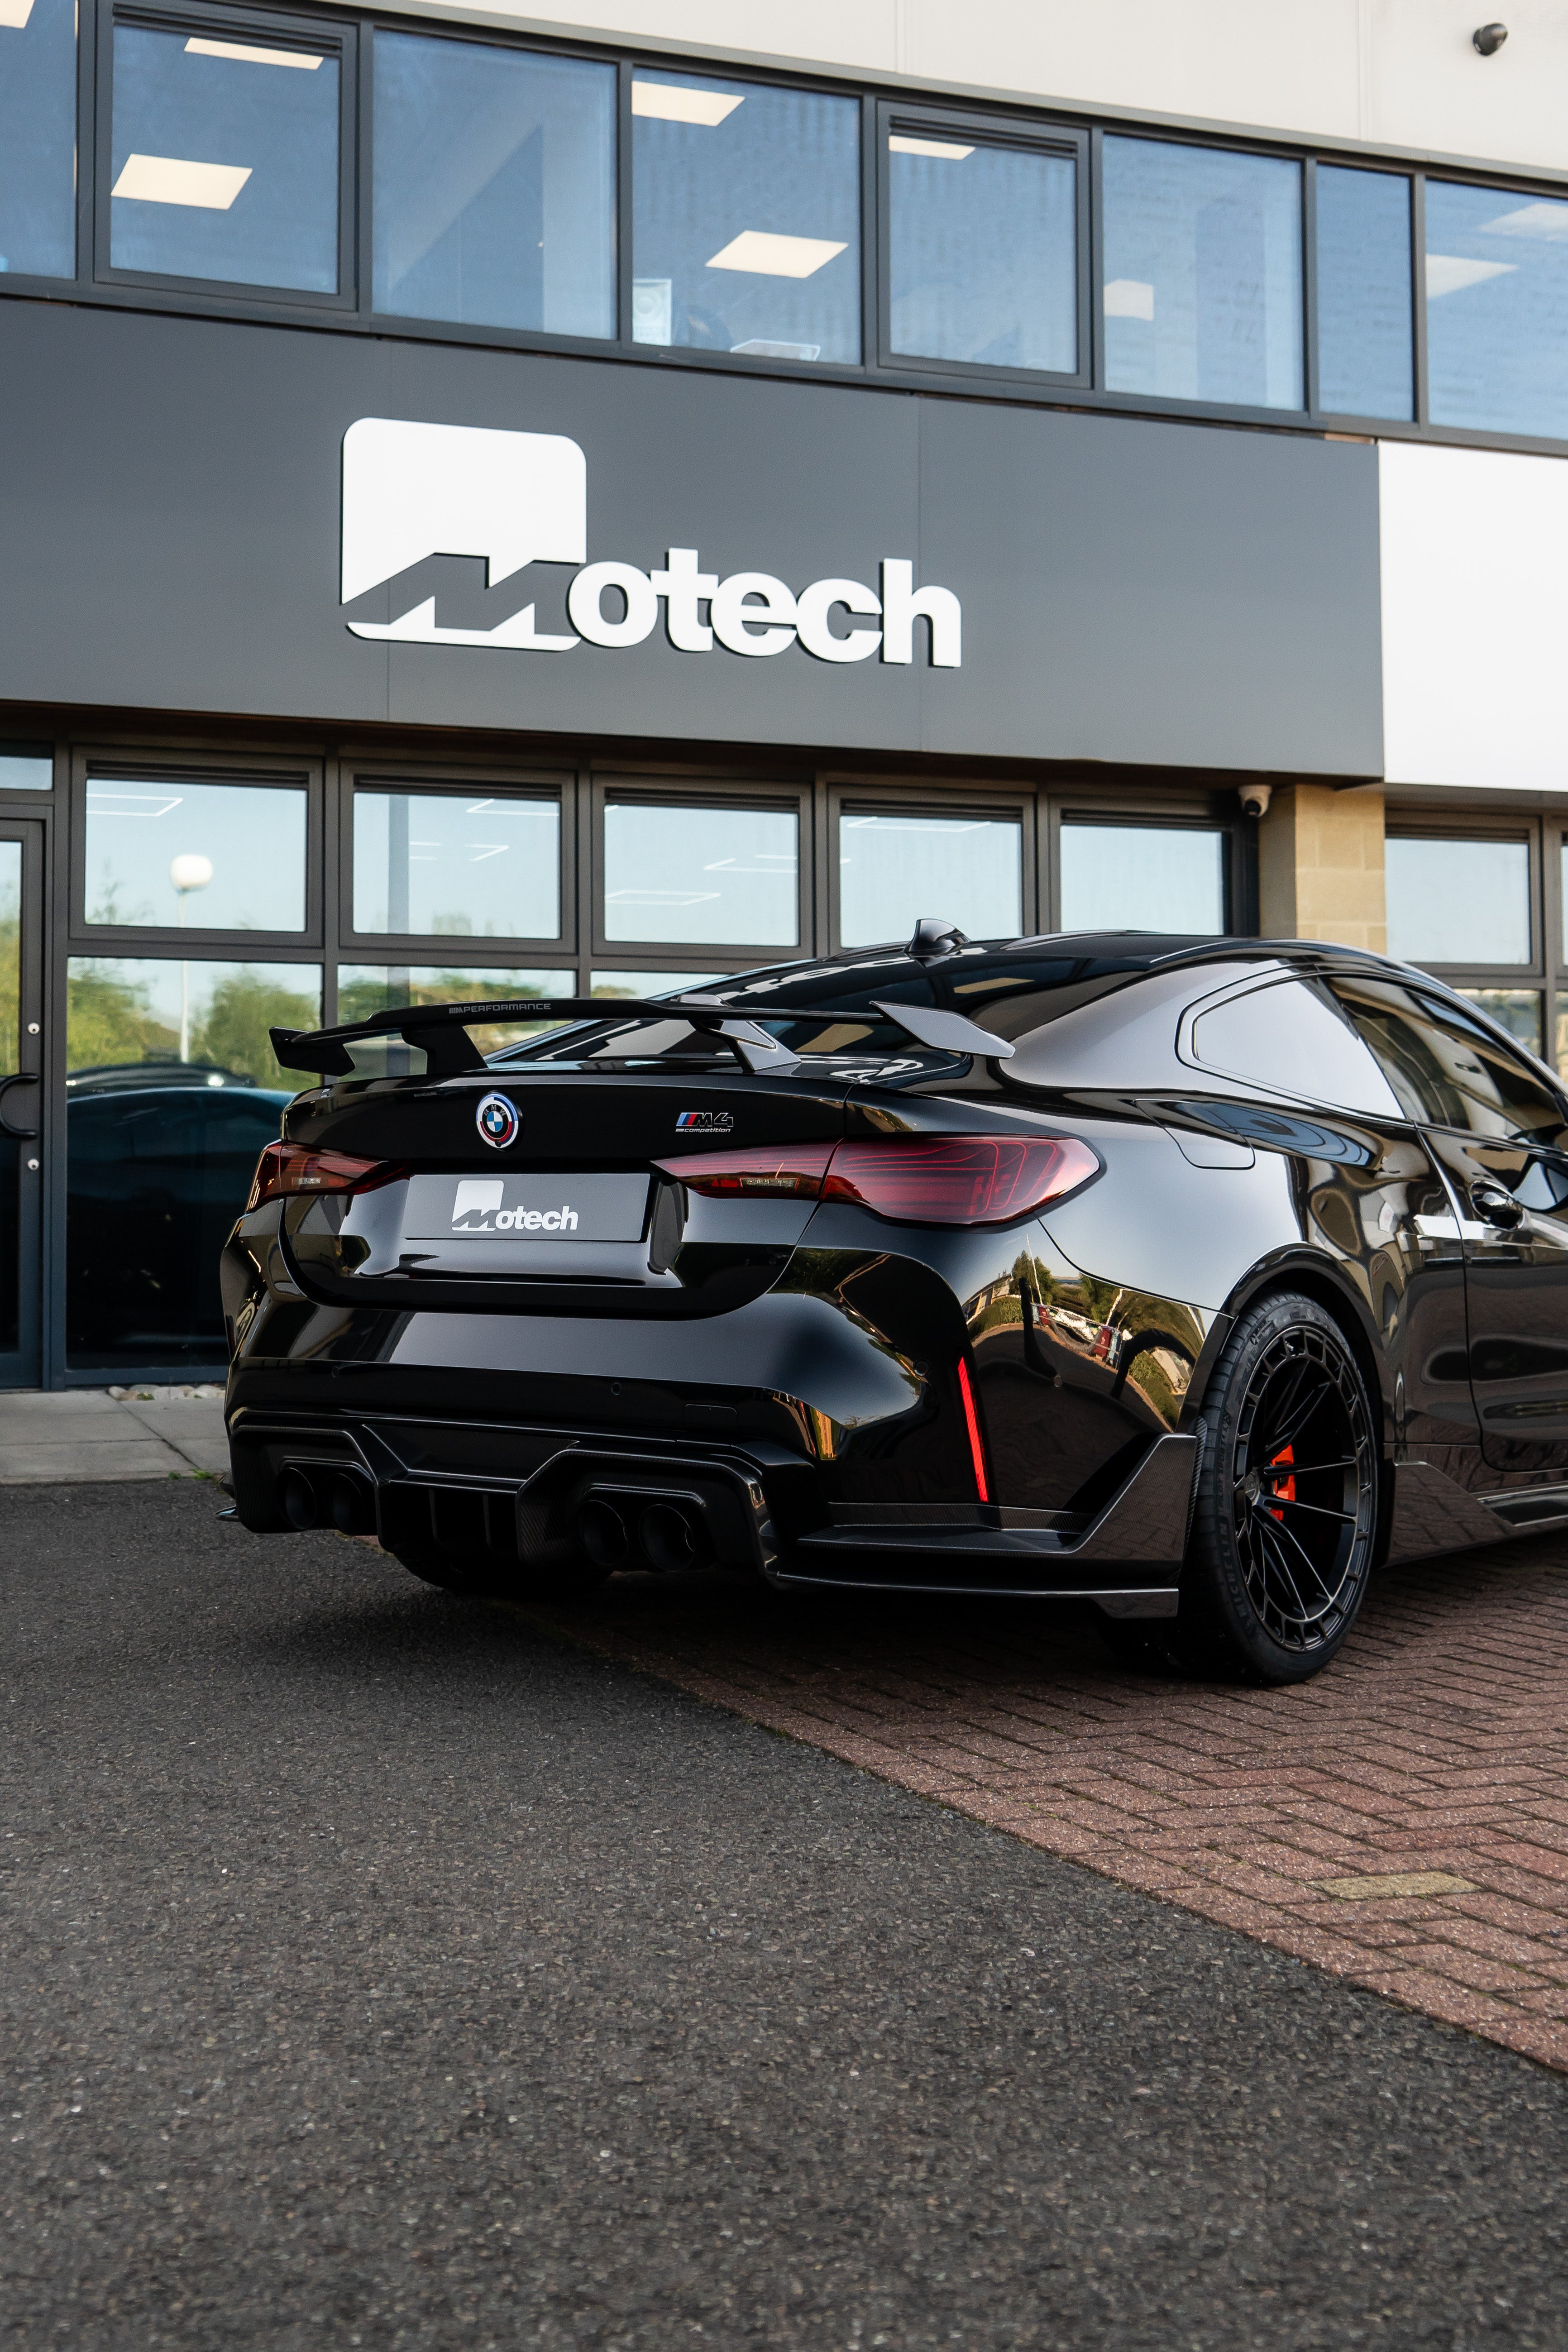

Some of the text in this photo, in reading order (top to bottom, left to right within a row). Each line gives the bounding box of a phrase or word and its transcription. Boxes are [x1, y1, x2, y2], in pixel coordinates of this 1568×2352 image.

[341, 417, 962, 668] Motech
[483, 1104, 507, 1117] BMW
[451, 1180, 578, 1232] Motech
[1219, 1523, 1247, 1618] MICHELIN
